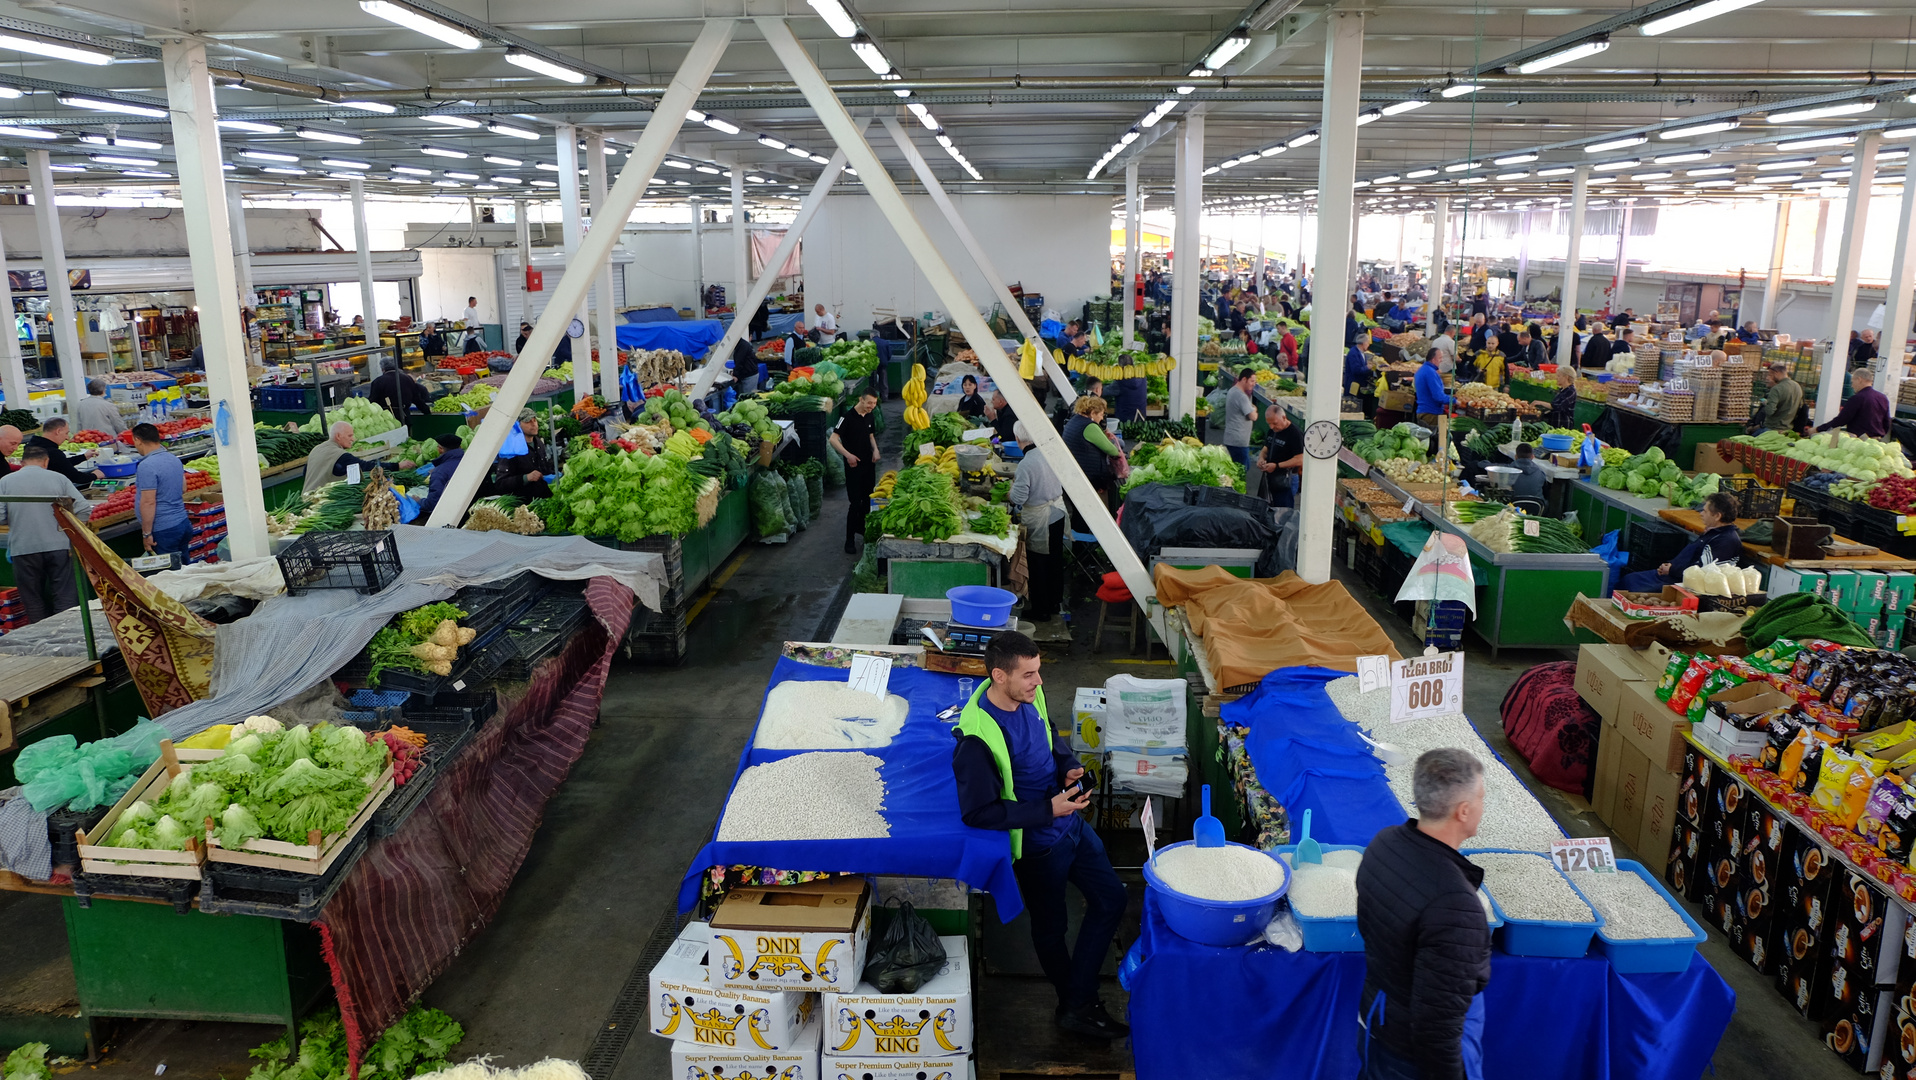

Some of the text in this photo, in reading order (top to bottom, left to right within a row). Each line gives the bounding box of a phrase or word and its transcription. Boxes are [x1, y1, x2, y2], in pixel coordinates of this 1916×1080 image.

[1695, 356, 1711, 366] 150
[1671, 380, 1688, 390] 150
[1525, 520, 1539, 535] 10
[853, 656, 886, 695] 70
[1408, 678, 1444, 710] 608
[1633, 710, 1655, 740] vipa
[1892, 802, 1912, 820] vipa
[1554, 846, 1606, 872] 120
[757, 936, 802, 954] KING
[660, 980, 771, 1005] Super Premium Quality Bananas
[837, 995, 859, 1005] Super
[860, 996, 896, 1004] Premium
[896, 996, 925, 1006] Quality
[701, 1020, 729, 1029] BANA
[693, 1026, 736, 1047] KING
[874, 1037, 920, 1053] KING
[684, 1054, 706, 1063] Super
[743, 1054, 771, 1063] Quality
[835, 1061, 857, 1071] Super
[893, 1061, 922, 1071] Quality
